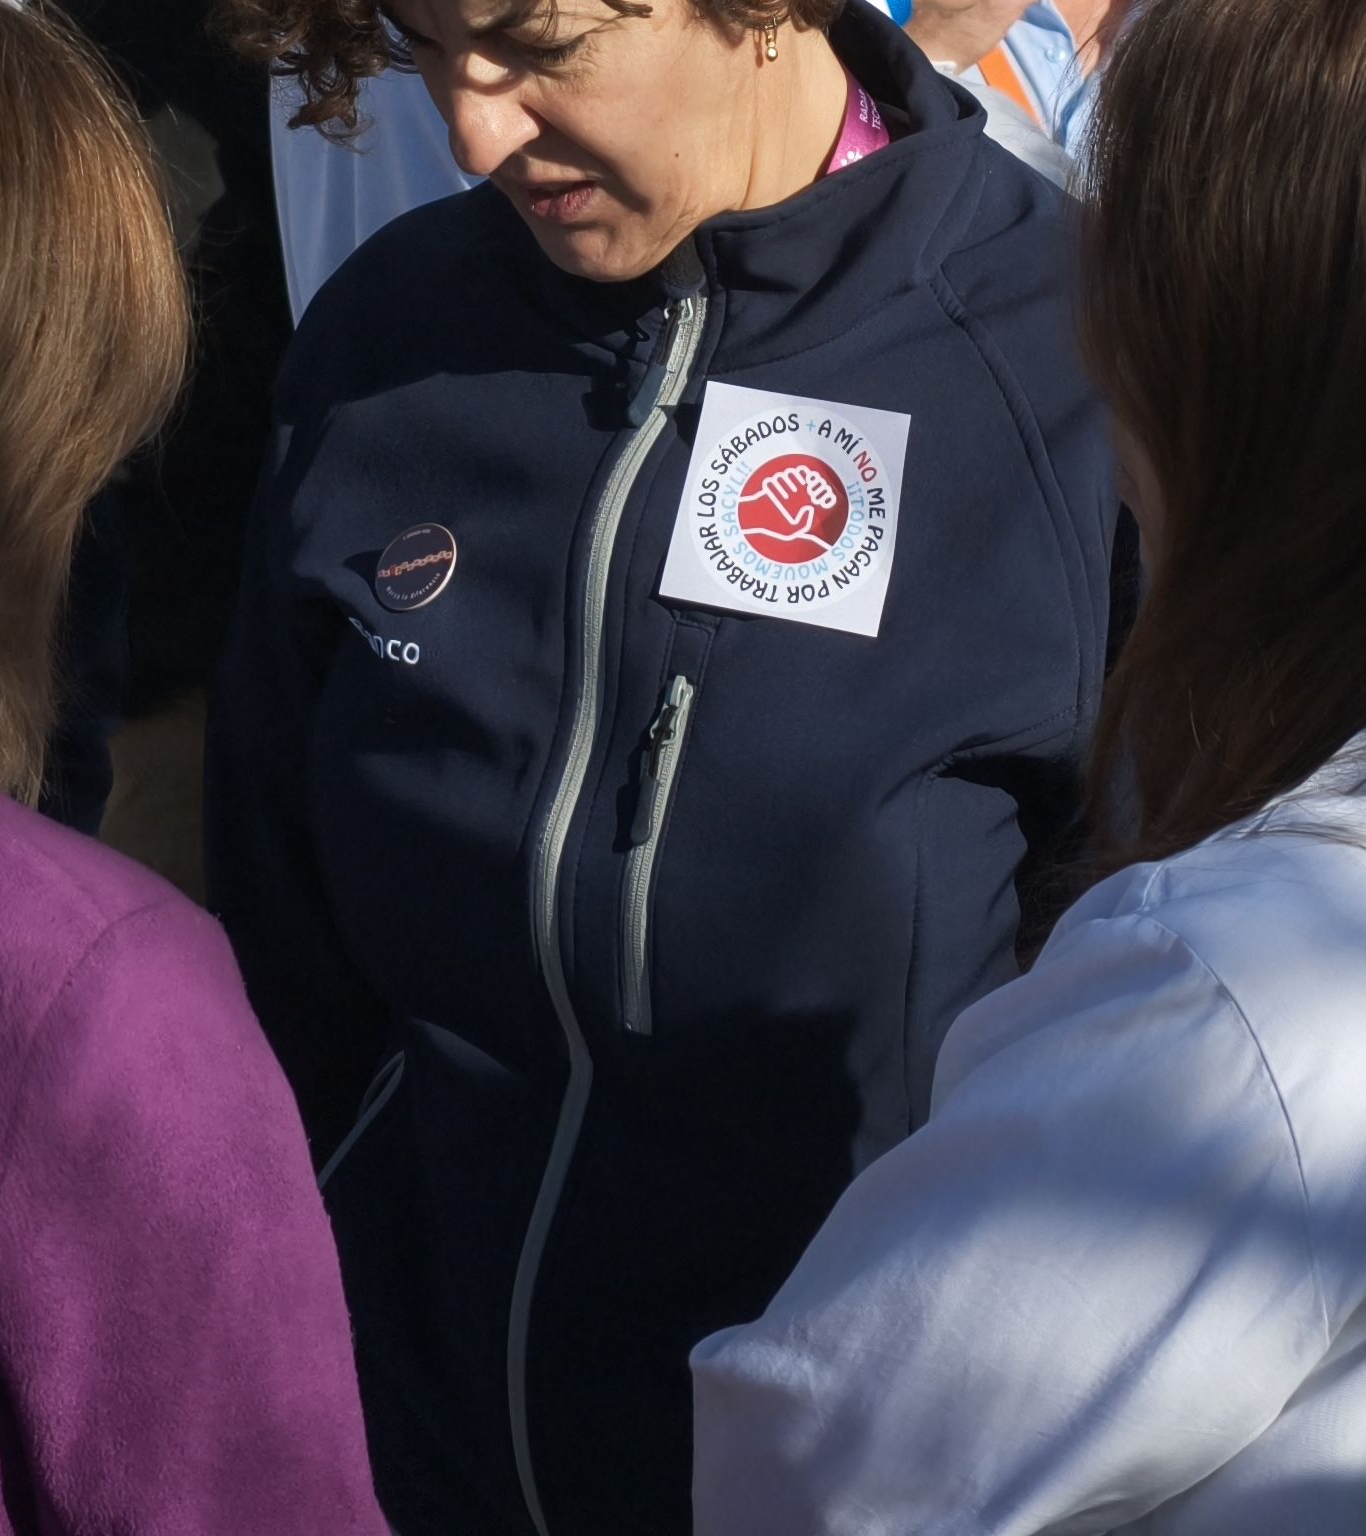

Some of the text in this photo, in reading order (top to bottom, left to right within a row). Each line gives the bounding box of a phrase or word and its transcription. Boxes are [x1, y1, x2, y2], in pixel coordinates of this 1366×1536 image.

[697, 413, 885, 603] A MÍ NO ME PAGAN POR TRABAJAR LOS SÁBADOS
[733, 543, 828, 580] MOVEMOS
